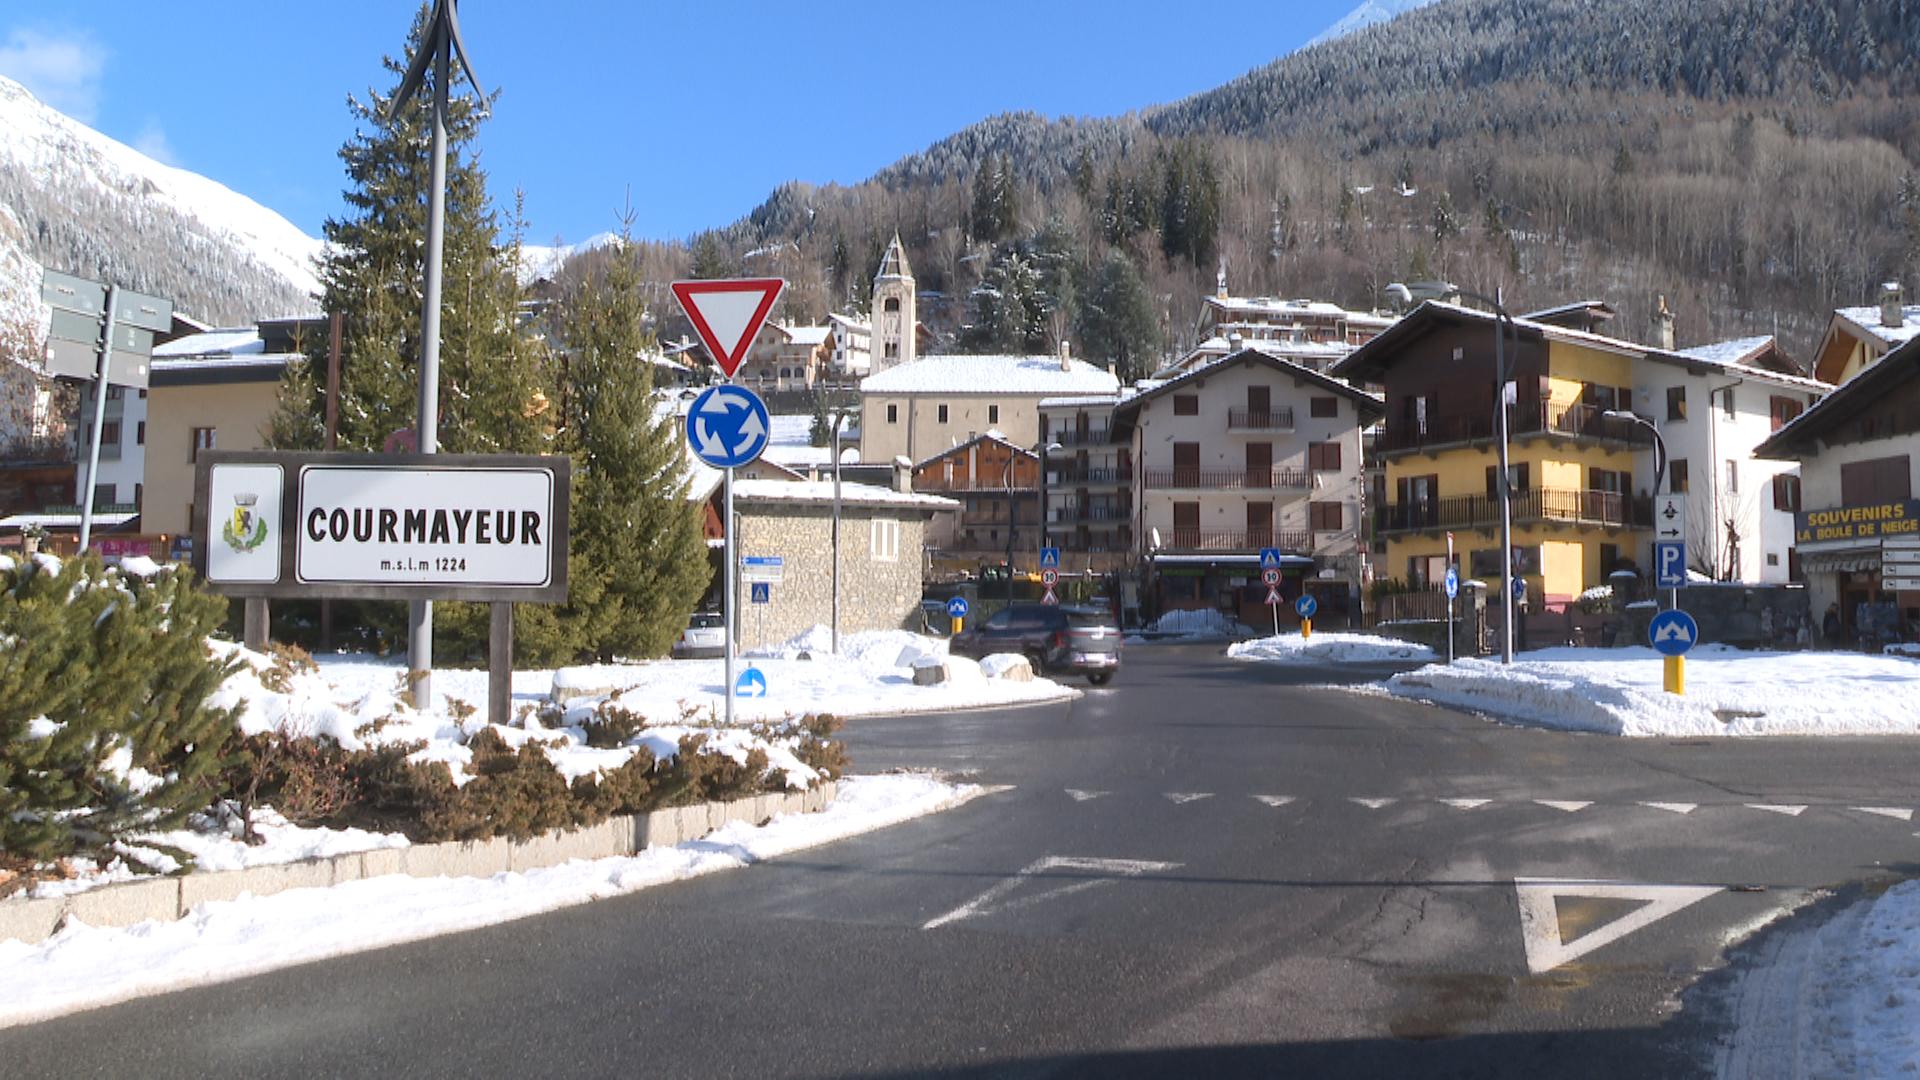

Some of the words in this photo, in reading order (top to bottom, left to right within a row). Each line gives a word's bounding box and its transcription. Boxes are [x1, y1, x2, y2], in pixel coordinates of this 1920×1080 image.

[307, 507, 542, 545] COURMAYEUR
[1808, 504, 1904, 526] SOUVENIRS
[1797, 529, 1811, 541] LA
[1817, 526, 1853, 540] BOULE
[1858, 523, 1875, 536] DE
[1881, 519, 1919, 534] NEIGE
[380, 557, 430, 571] m.s.l.m
[435, 558, 467, 572] 1224
[1662, 546, 1680, 577] P
